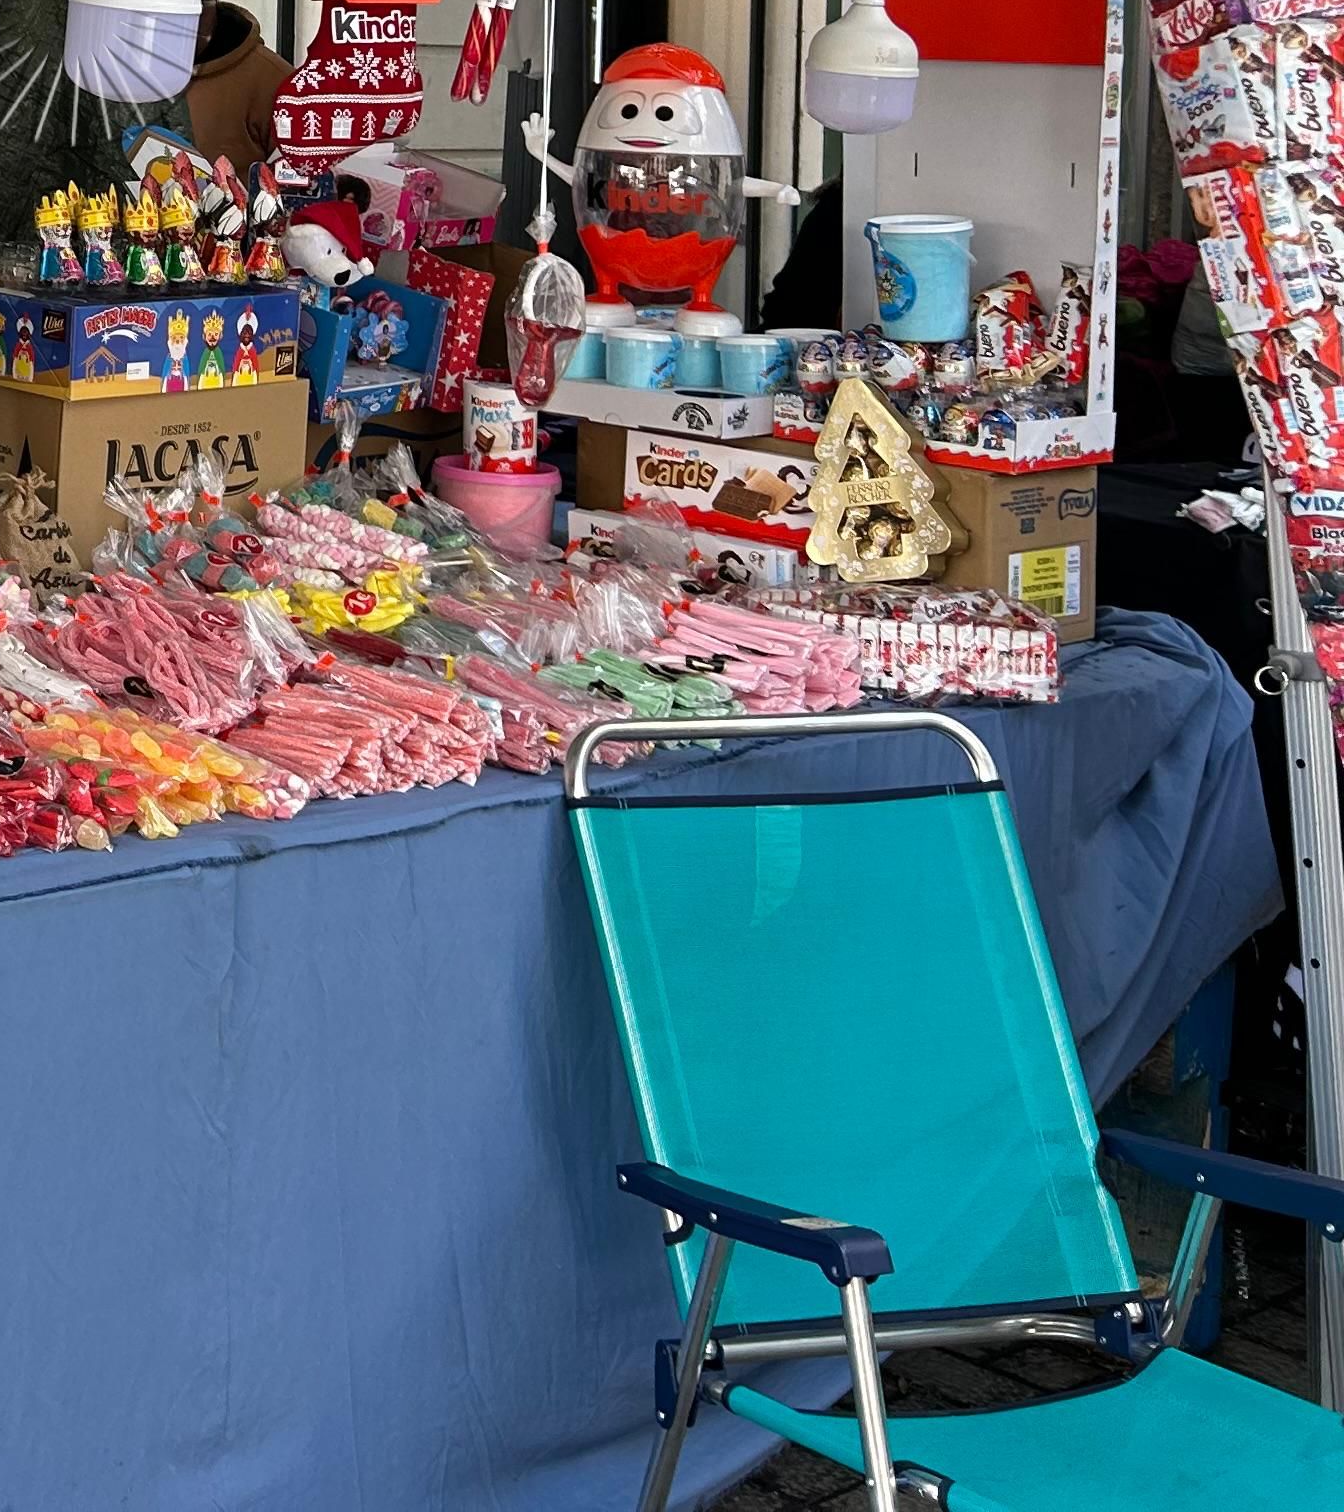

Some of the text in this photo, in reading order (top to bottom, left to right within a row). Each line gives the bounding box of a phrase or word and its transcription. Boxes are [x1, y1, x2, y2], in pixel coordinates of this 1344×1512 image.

[586, 170, 714, 217] Kinder
[1051, 300, 1072, 352] bueno
[981, 323, 997, 358] bueno
[470, 394, 505, 410] Kinder
[470, 406, 513, 425] Maxi
[160, 425, 193, 437] DESDE
[106, 433, 260, 486] LACASA
[648, 440, 686, 460] Kinder
[639, 457, 716, 491] Cards
[923, 600, 968, 617] bueno
